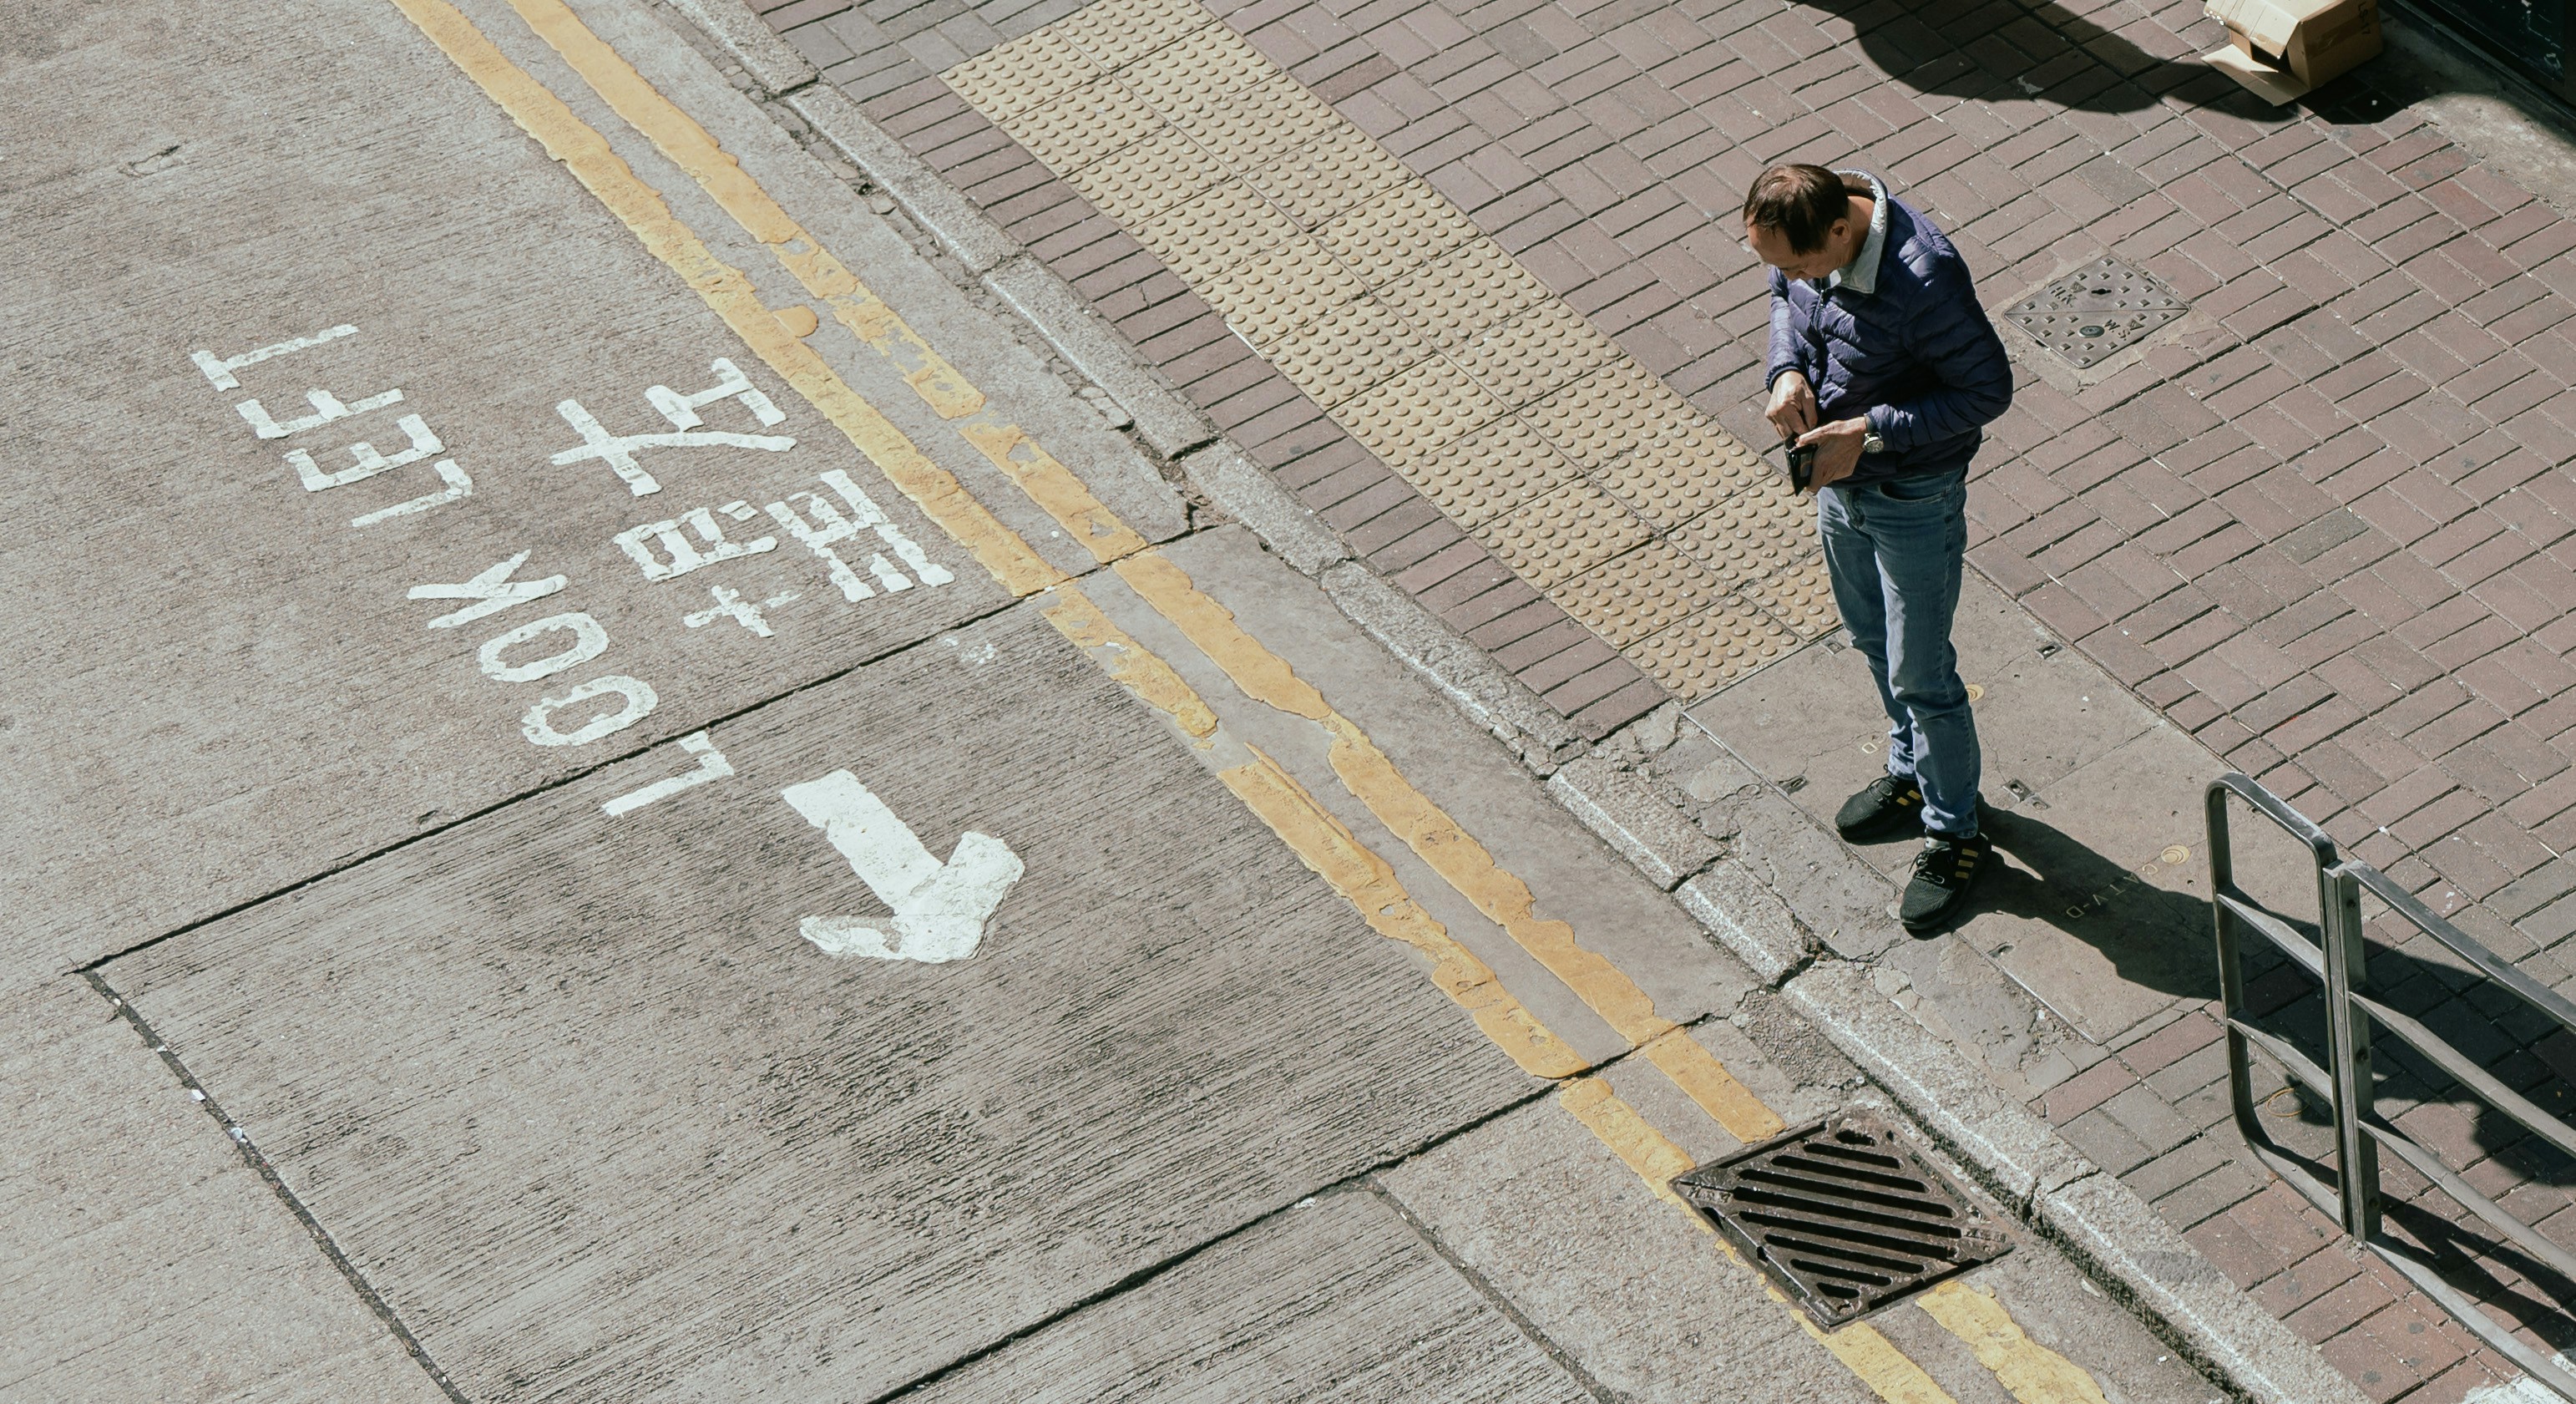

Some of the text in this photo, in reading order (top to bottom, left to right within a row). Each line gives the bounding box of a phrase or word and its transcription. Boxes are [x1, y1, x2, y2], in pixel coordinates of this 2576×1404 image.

[191, 323, 735, 818] LOOK LEFT
[550, 357, 955, 638] 望左
[2066, 863, 2159, 919] CATV-D
